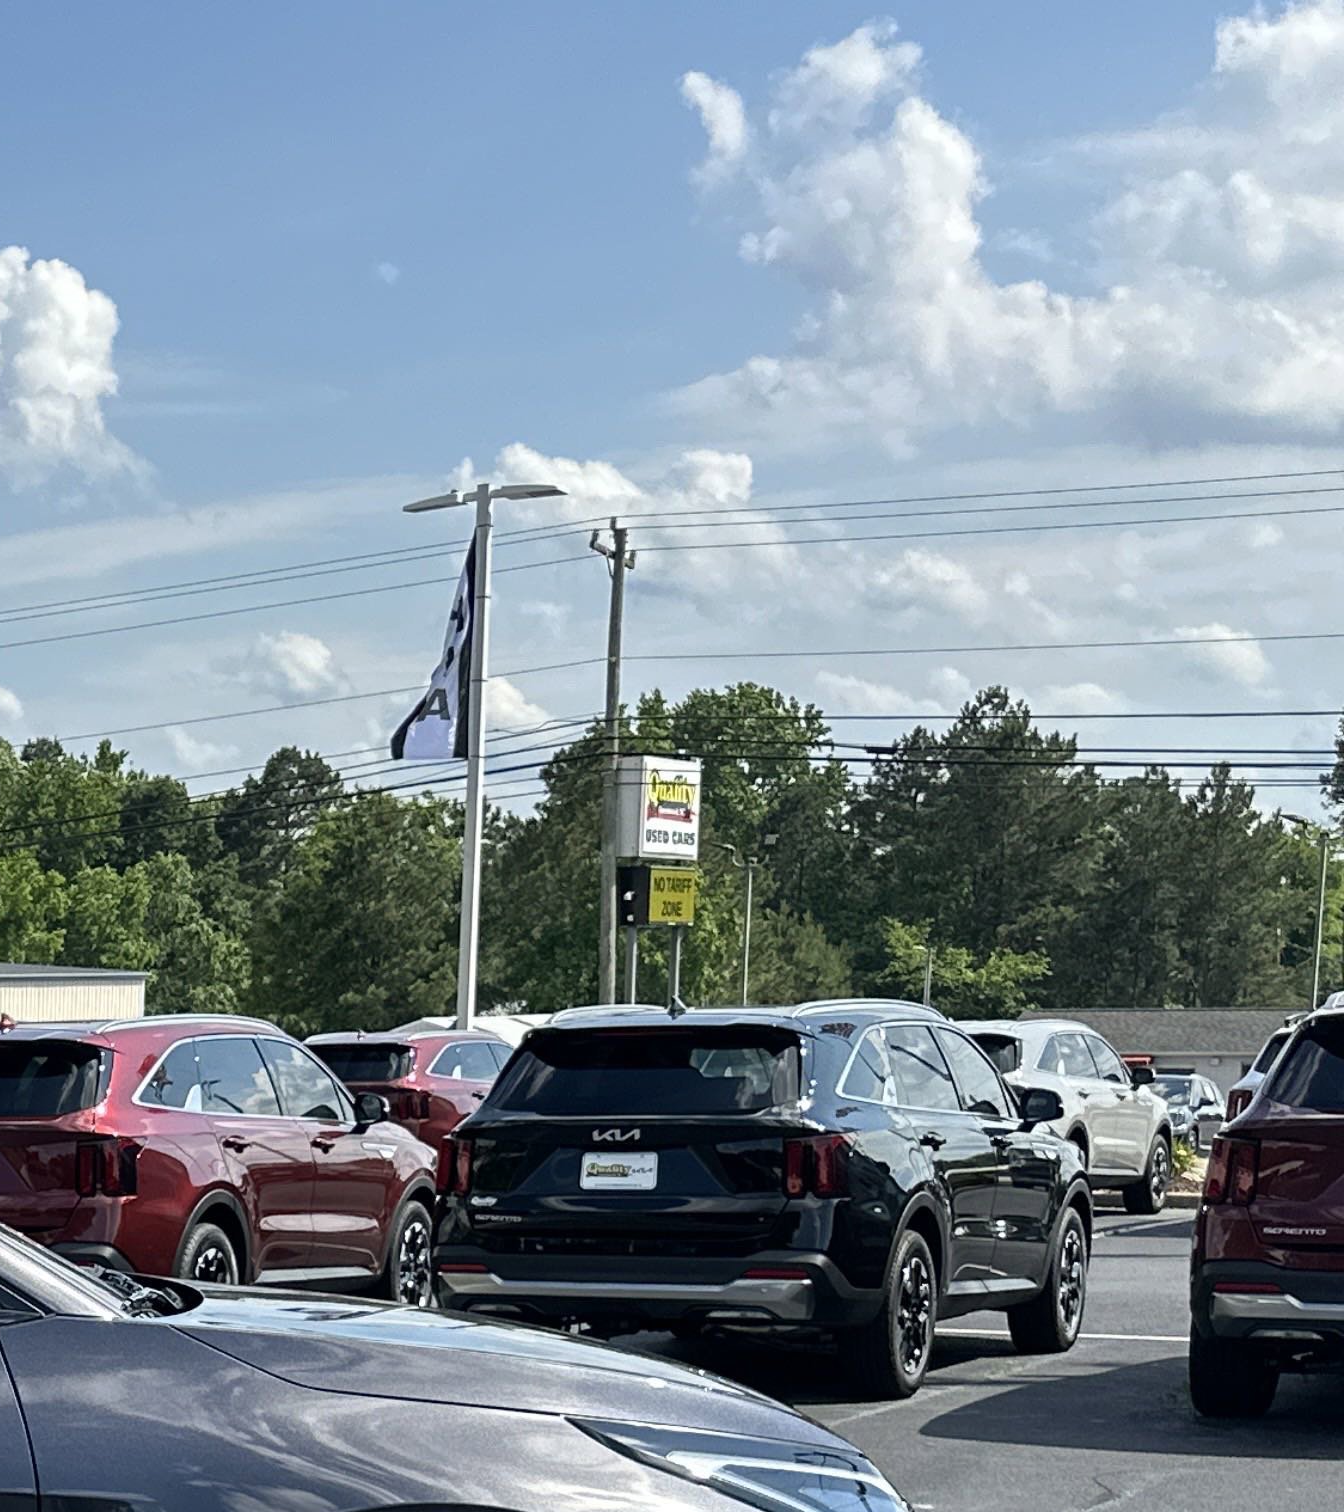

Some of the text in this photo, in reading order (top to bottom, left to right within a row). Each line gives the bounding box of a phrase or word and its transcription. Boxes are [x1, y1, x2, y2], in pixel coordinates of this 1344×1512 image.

[647, 769, 697, 809] Quality
[646, 829, 696, 845] USED CARS
[654, 876, 665, 892] NO
[661, 900, 682, 917] ZONE
[592, 1128, 641, 1141] KIA
